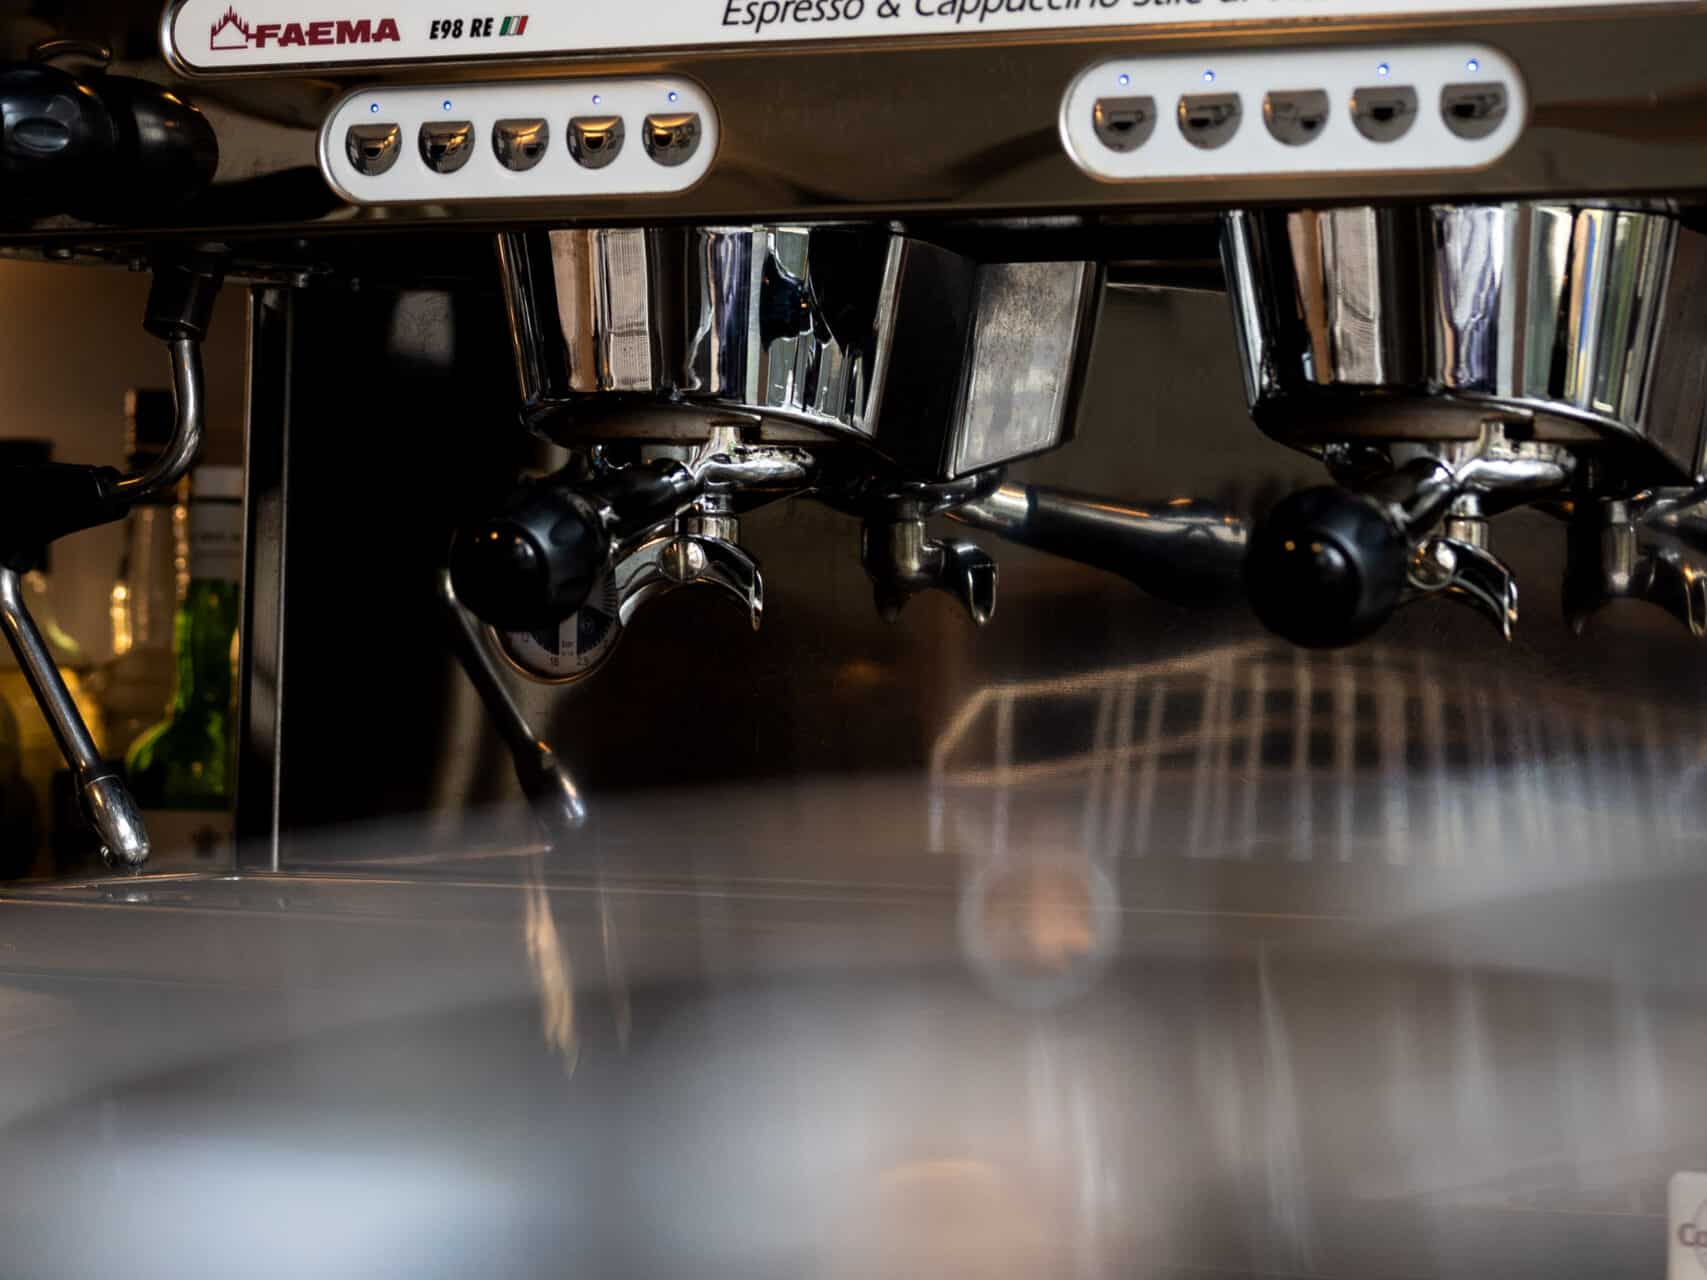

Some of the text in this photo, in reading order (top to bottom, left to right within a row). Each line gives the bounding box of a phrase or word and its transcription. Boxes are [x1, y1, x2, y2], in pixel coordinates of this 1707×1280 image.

[254, 17, 494, 48] FAEMA E98 RE
